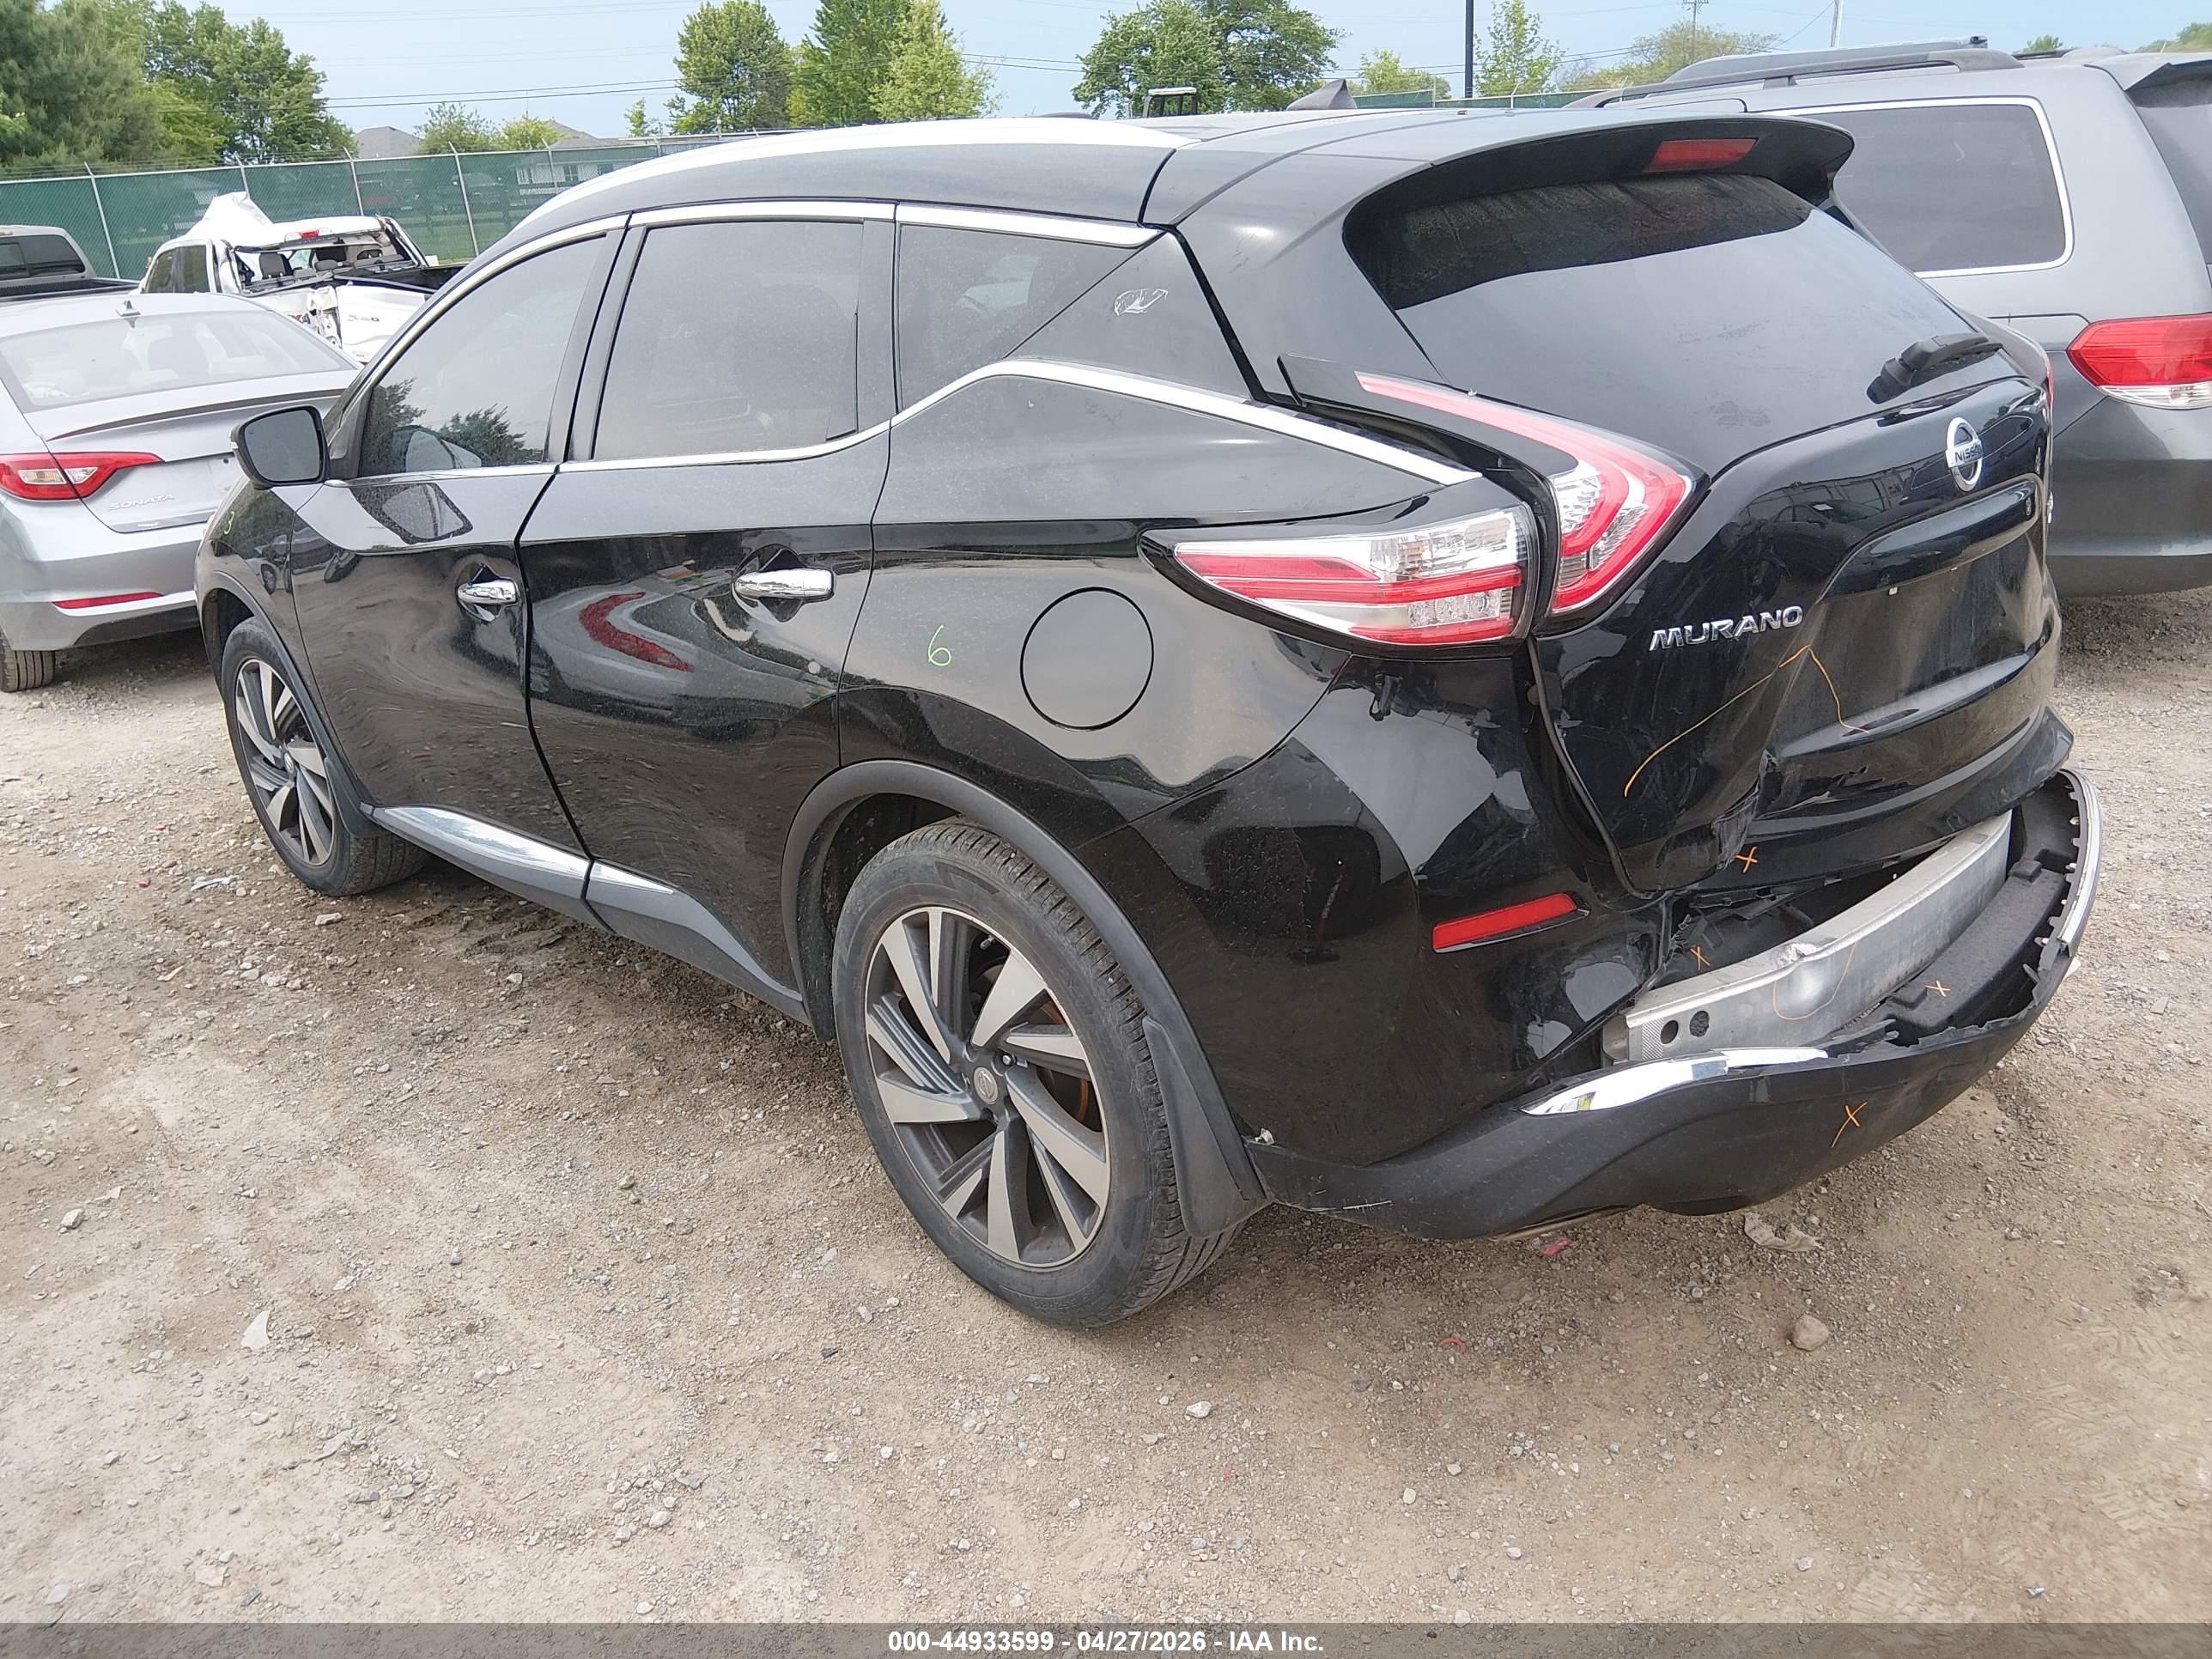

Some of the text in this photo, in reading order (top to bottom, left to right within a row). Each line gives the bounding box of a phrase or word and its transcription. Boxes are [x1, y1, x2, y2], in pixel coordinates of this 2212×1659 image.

[108, 495, 175, 511] SONATA
[927, 624, 951, 666] 6
[1649, 605, 1803, 651] MURANO
